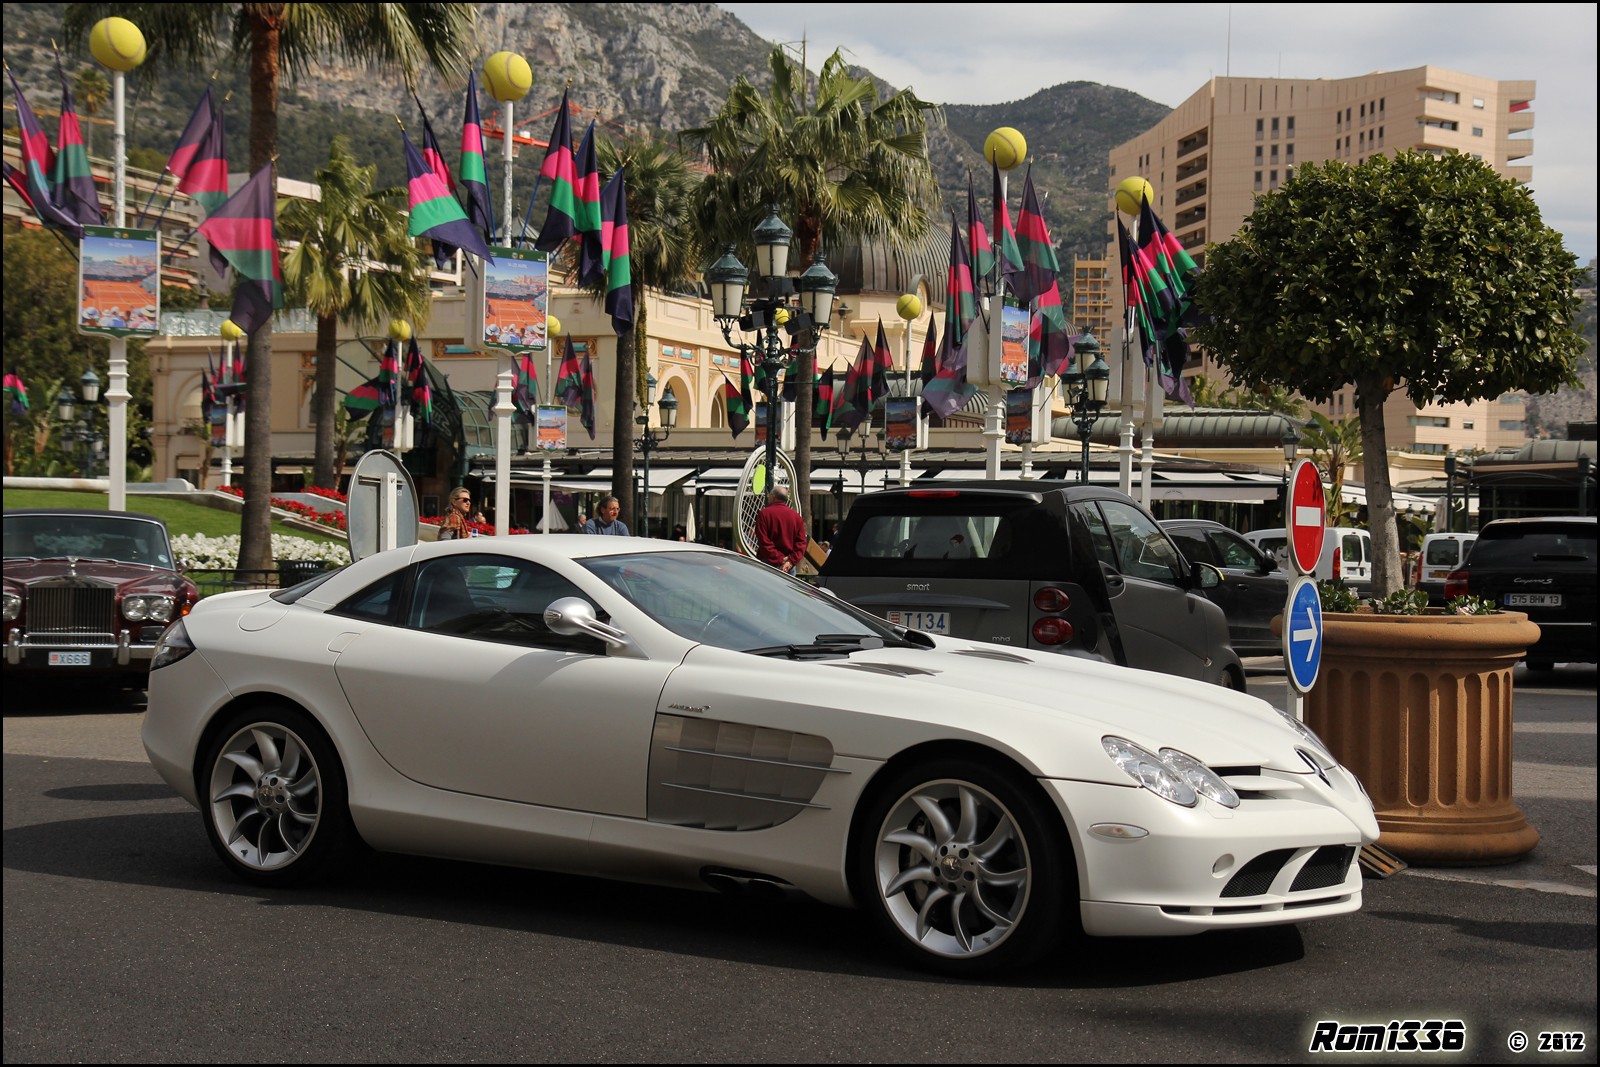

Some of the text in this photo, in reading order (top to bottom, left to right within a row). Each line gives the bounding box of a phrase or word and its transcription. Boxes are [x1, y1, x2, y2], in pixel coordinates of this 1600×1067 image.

[906, 583, 930, 591] smart
[1511, 595, 1527, 604] 575
[1549, 596, 1559, 604] 13
[904, 612, 946, 630] T134
[59, 654, 88, 664] X666
